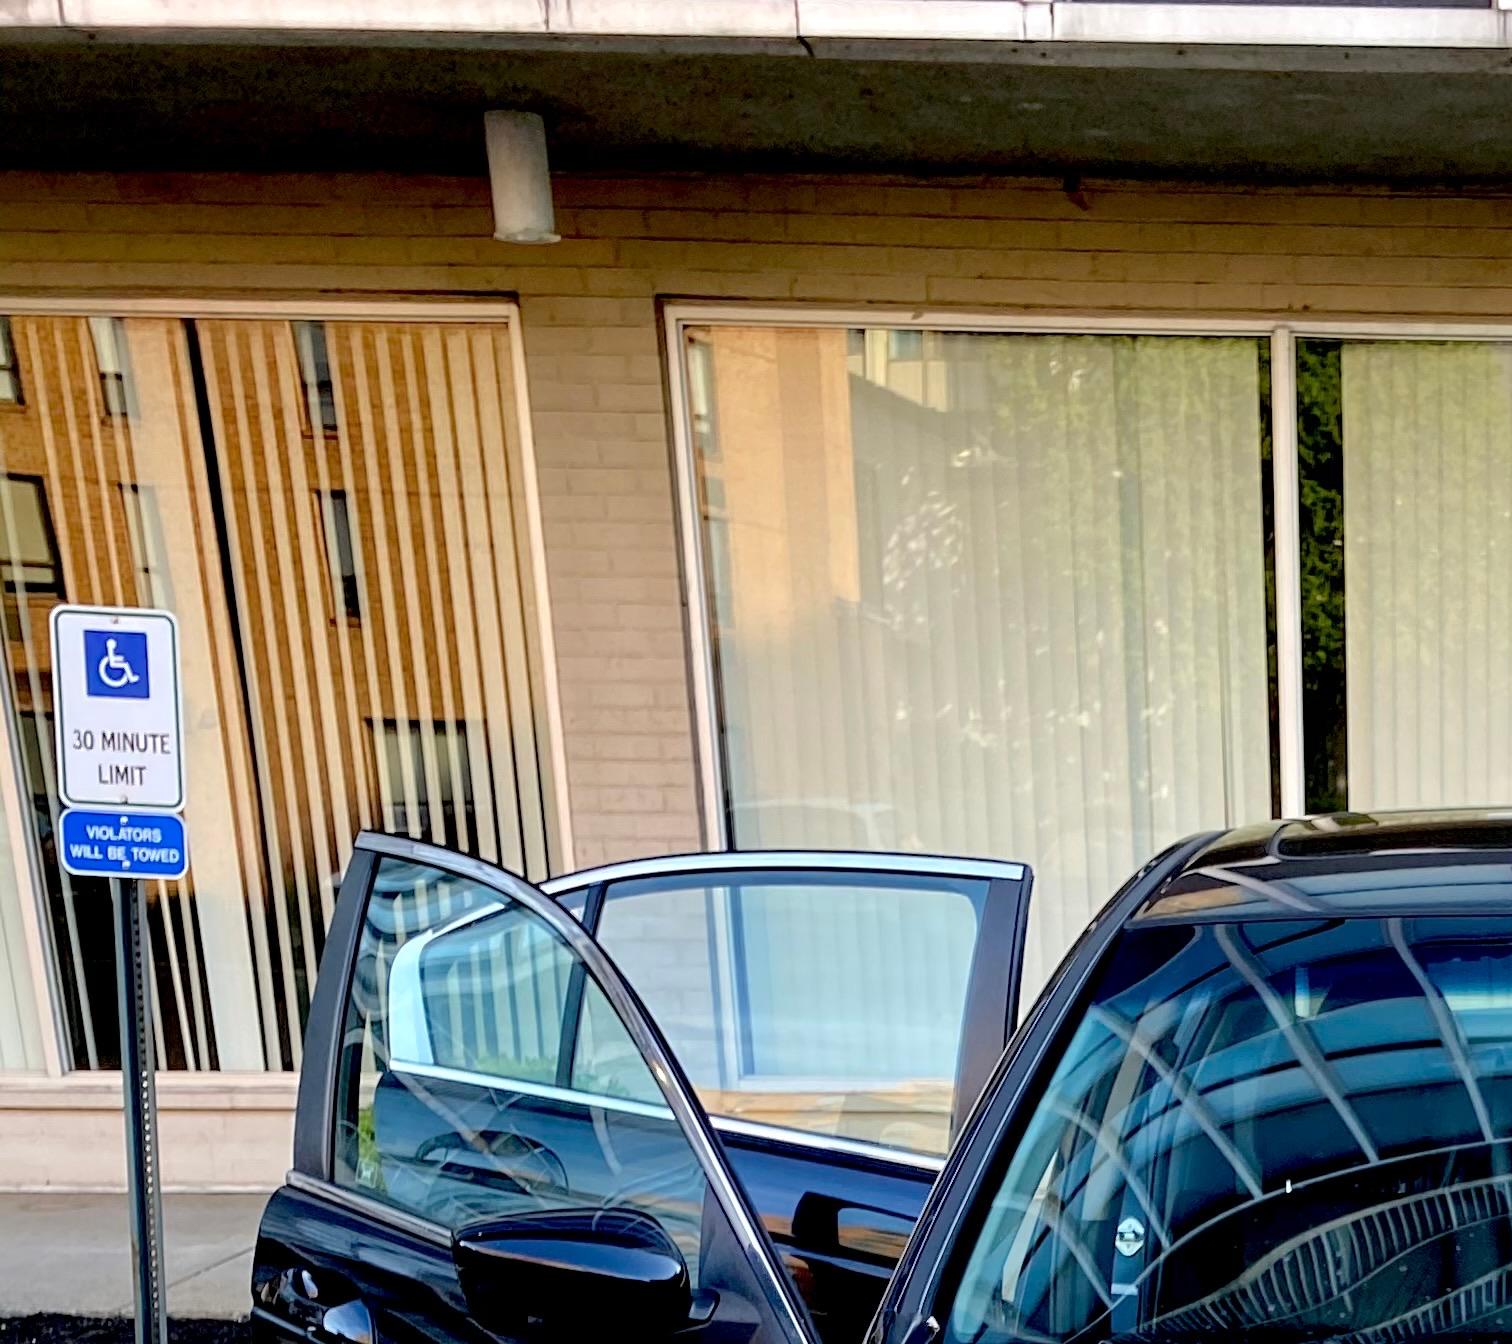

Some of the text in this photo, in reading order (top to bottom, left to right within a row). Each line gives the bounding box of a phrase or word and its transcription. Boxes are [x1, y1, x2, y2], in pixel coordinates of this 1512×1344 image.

[72, 730, 171, 754] 30 MINUTE
[98, 765, 146, 786] LIMIT
[85, 825, 162, 843] VIOLATORS
[69, 844, 180, 864] WILL BE TOWED
